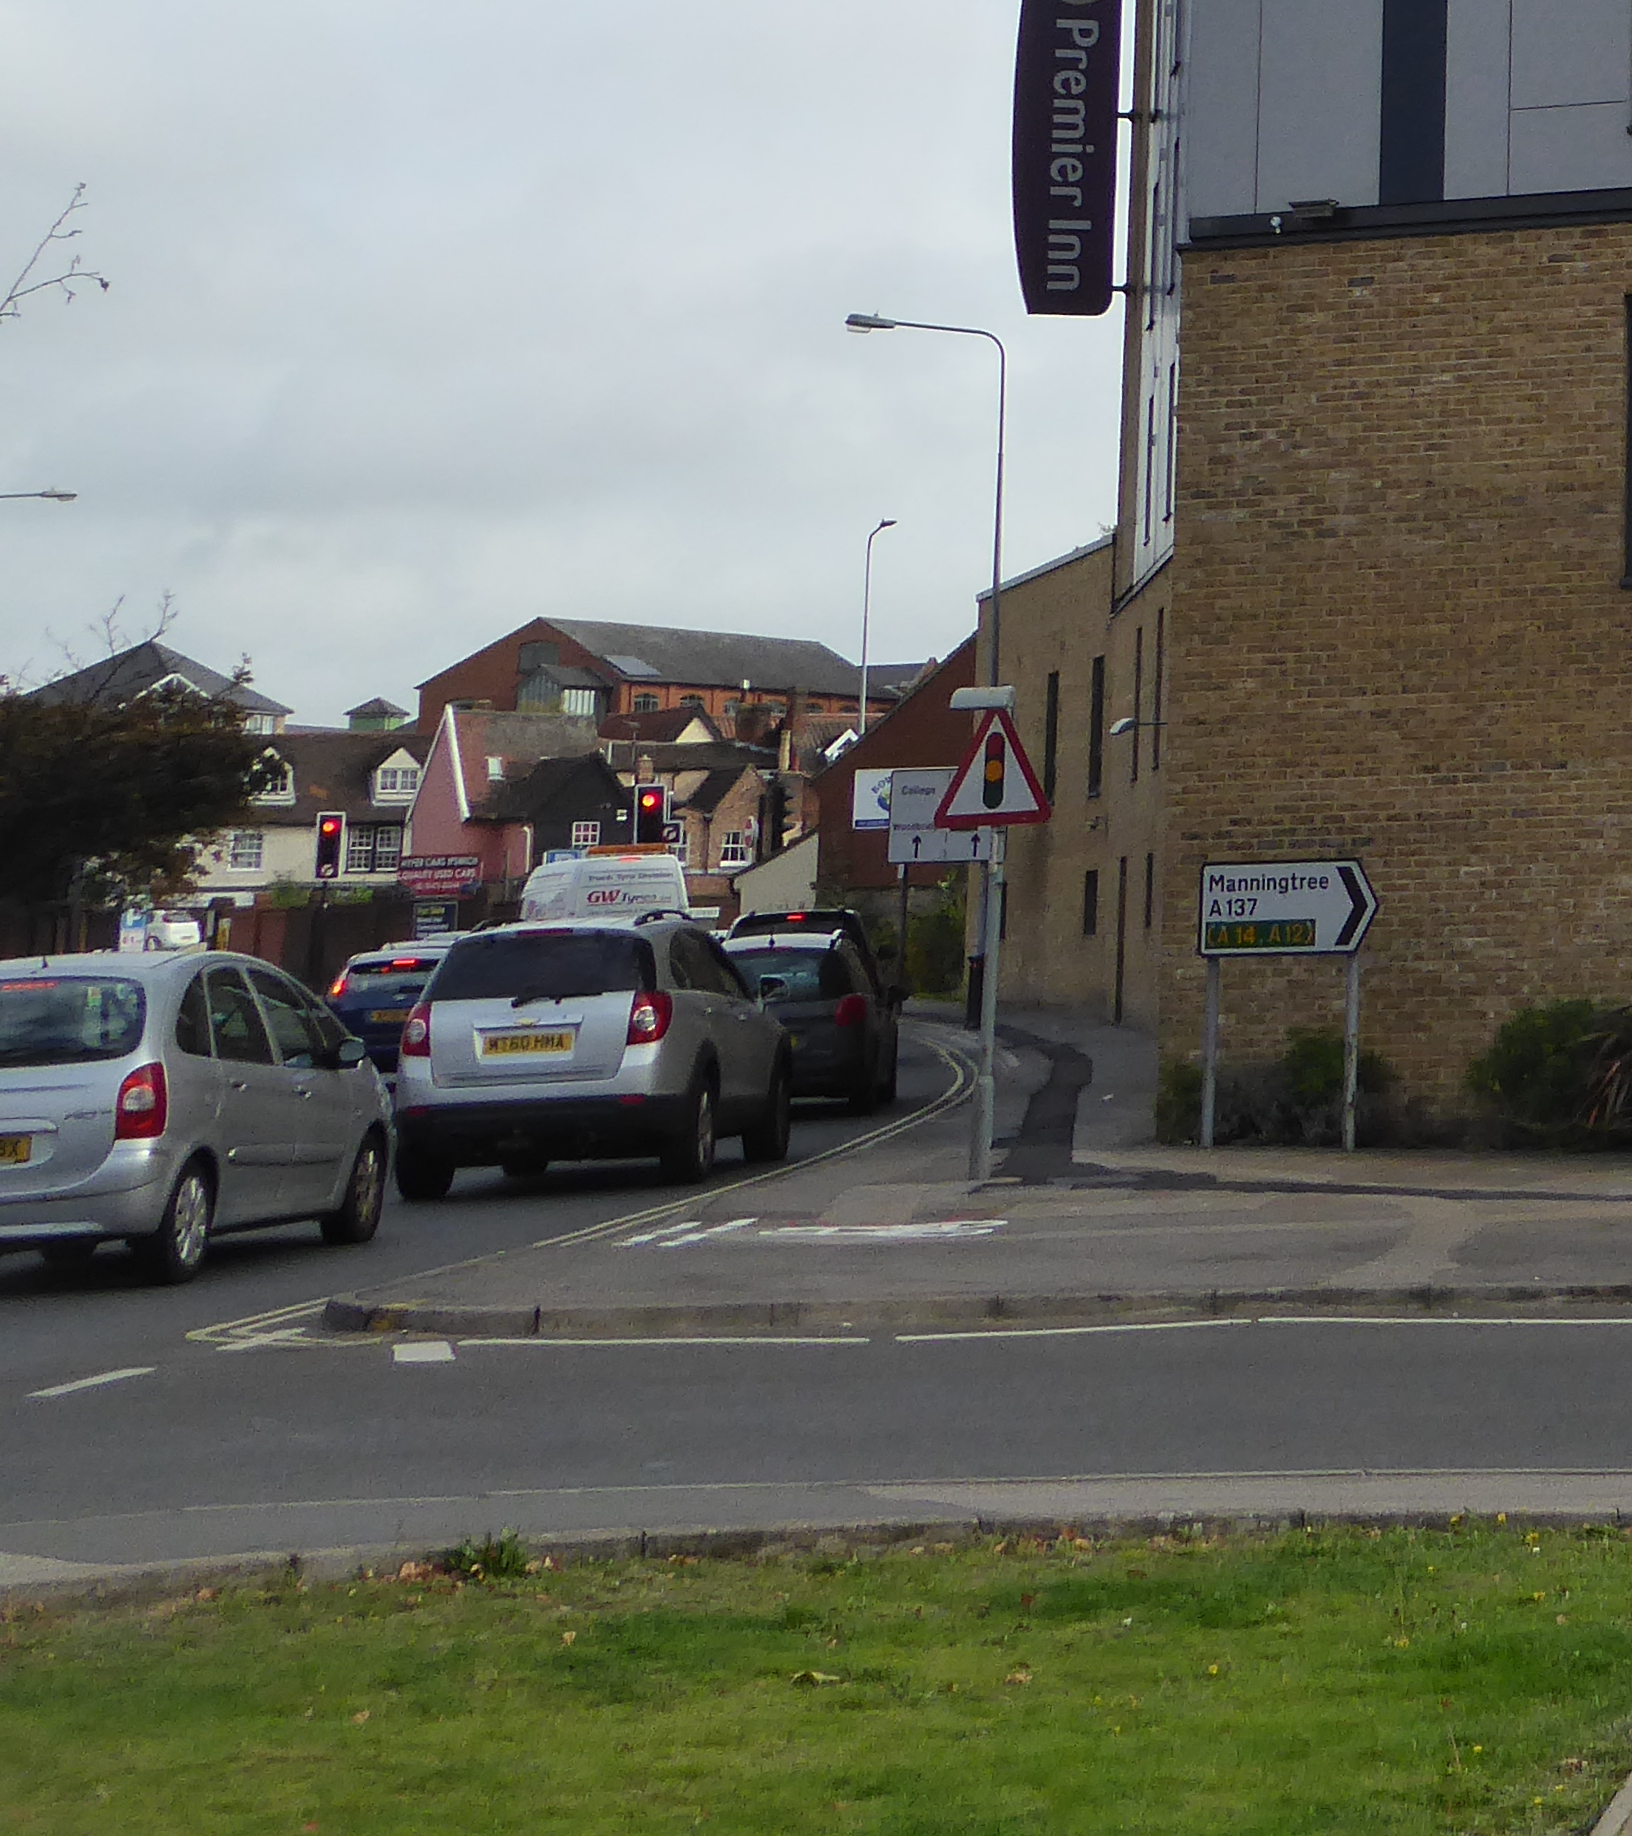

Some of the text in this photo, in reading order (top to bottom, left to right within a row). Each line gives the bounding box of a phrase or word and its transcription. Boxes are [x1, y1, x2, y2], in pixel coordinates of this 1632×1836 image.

[1046, 17, 1100, 293] Premier Inn
[455, 868, 476, 878] CARS
[1209, 872, 1329, 894] Manningtree
[587, 889, 620, 904] GW
[1209, 898, 1258, 917] A137
